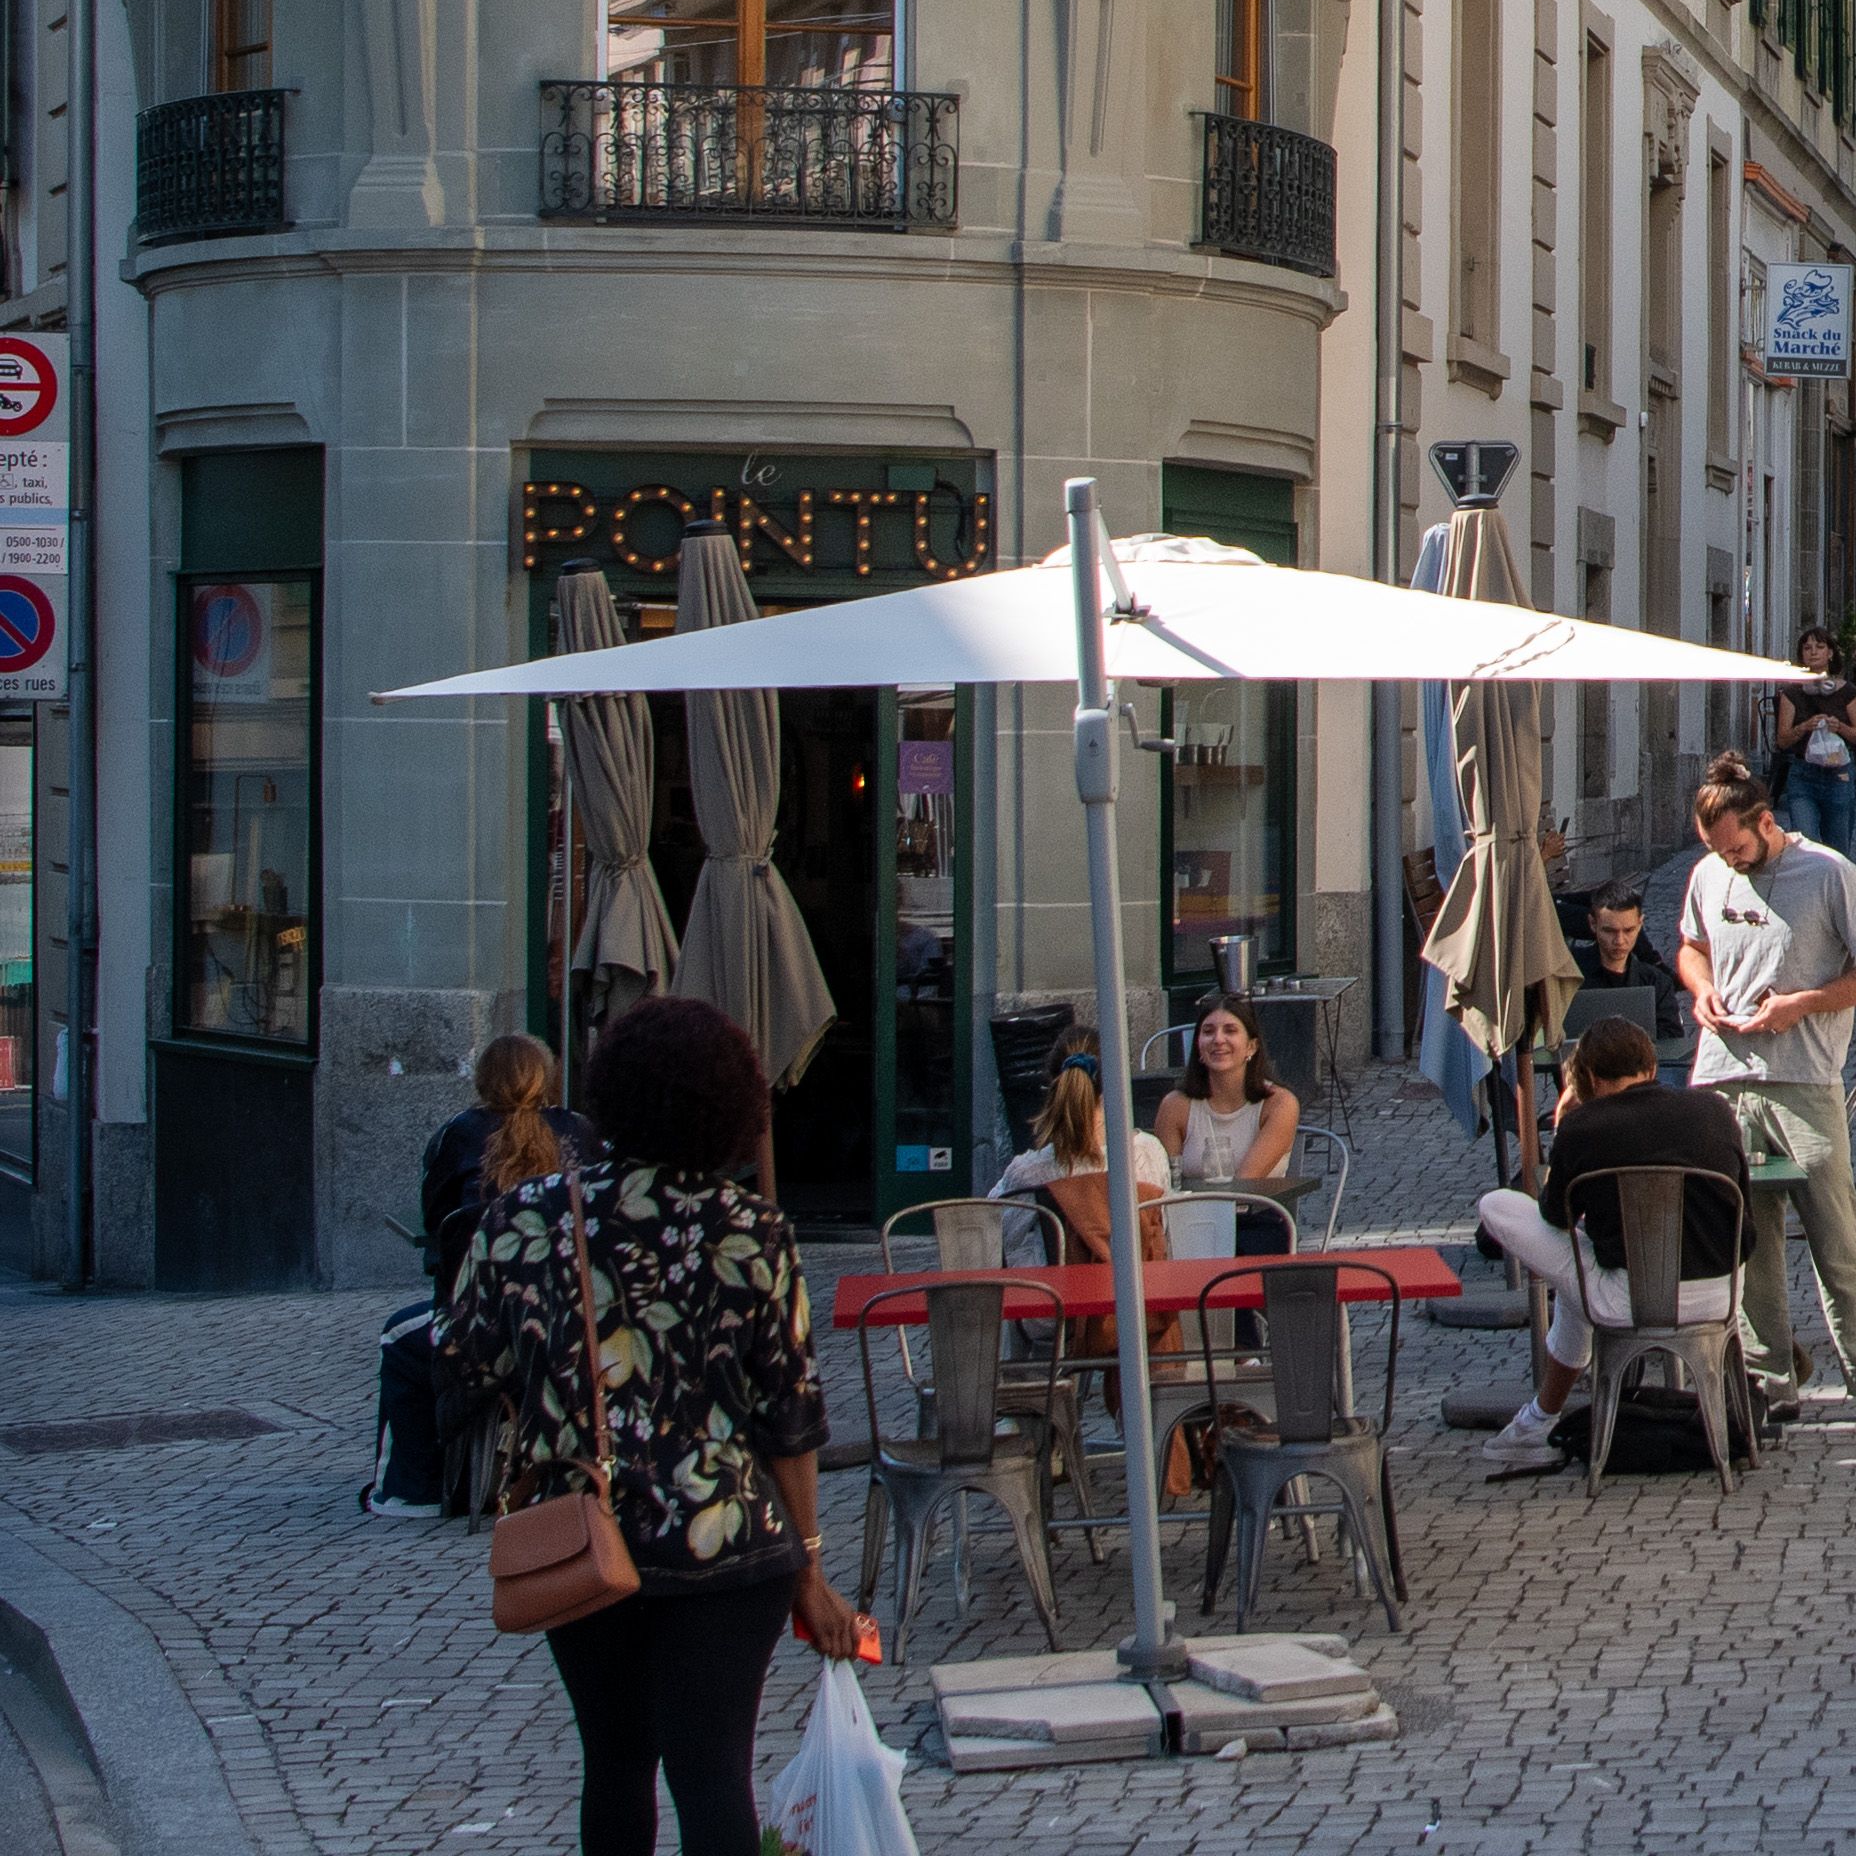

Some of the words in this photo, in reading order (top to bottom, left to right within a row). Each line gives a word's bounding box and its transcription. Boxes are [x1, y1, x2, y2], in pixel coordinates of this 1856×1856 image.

[1773, 327, 1818, 340] Snack
[1822, 328, 1841, 341] du
[1773, 340, 1841, 356] Marché
[739, 447, 783, 487] le
[23, 476, 48, 490] taxi,
[9, 492, 53, 506] publics,
[25, 678, 56, 691] rues
